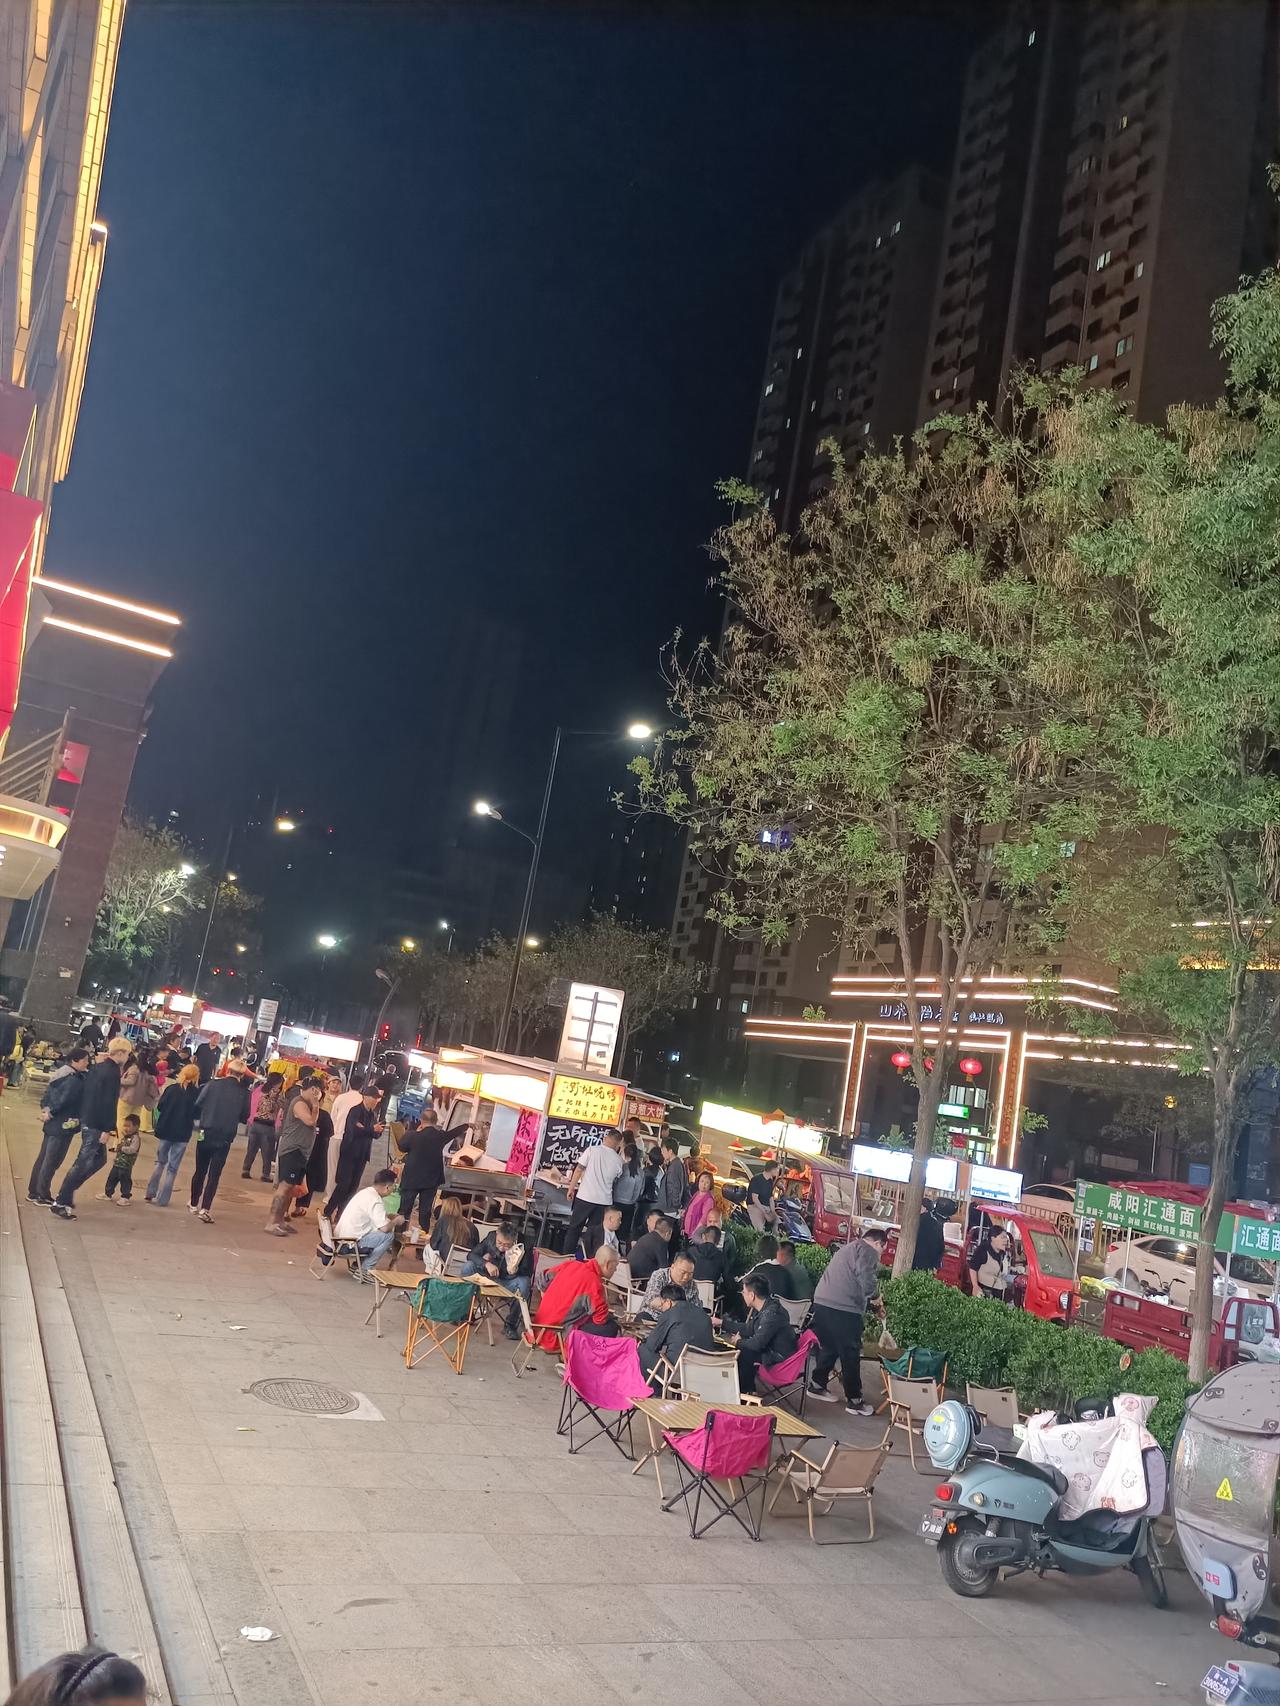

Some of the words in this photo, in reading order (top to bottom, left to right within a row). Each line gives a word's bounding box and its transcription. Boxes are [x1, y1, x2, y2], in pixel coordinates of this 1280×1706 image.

[1107, 1192, 1196, 1228] 咸阳汇通面
